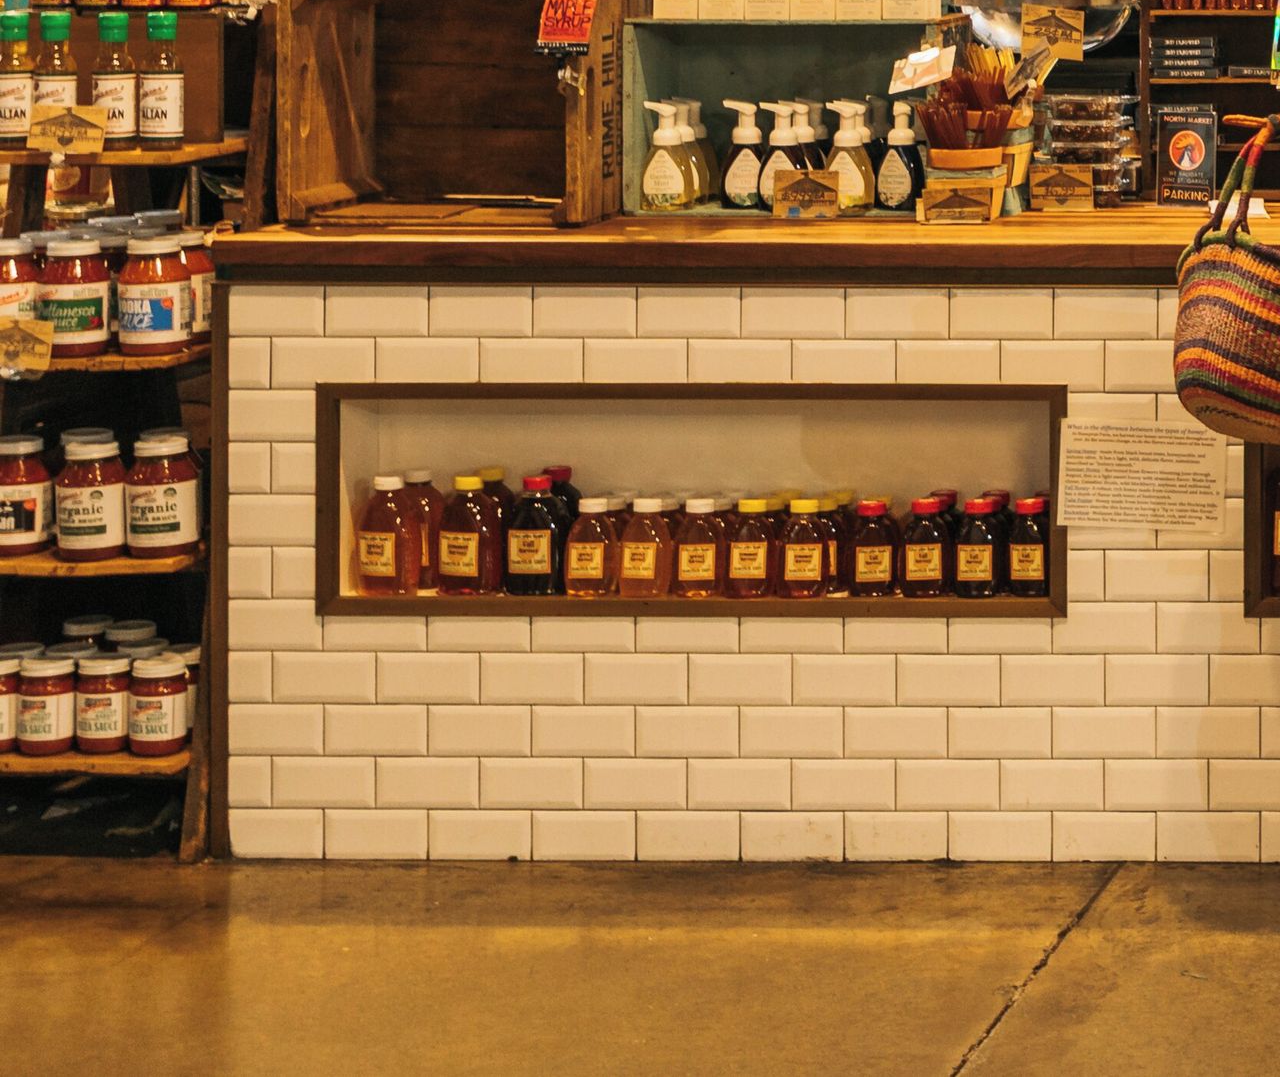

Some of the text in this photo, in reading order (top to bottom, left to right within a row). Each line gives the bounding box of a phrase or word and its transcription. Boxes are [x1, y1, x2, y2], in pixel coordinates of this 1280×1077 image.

[544, 15, 592, 29] SYRUP
[602, 22, 615, 179] ROME HILL
[0, 108, 26, 120] ALIAN
[142, 108, 168, 120] ALIAN
[1164, 115, 1186, 123] NORTH
[1164, 188, 1209, 202] PARKING
[1100, 425, 1127, 433] difference
